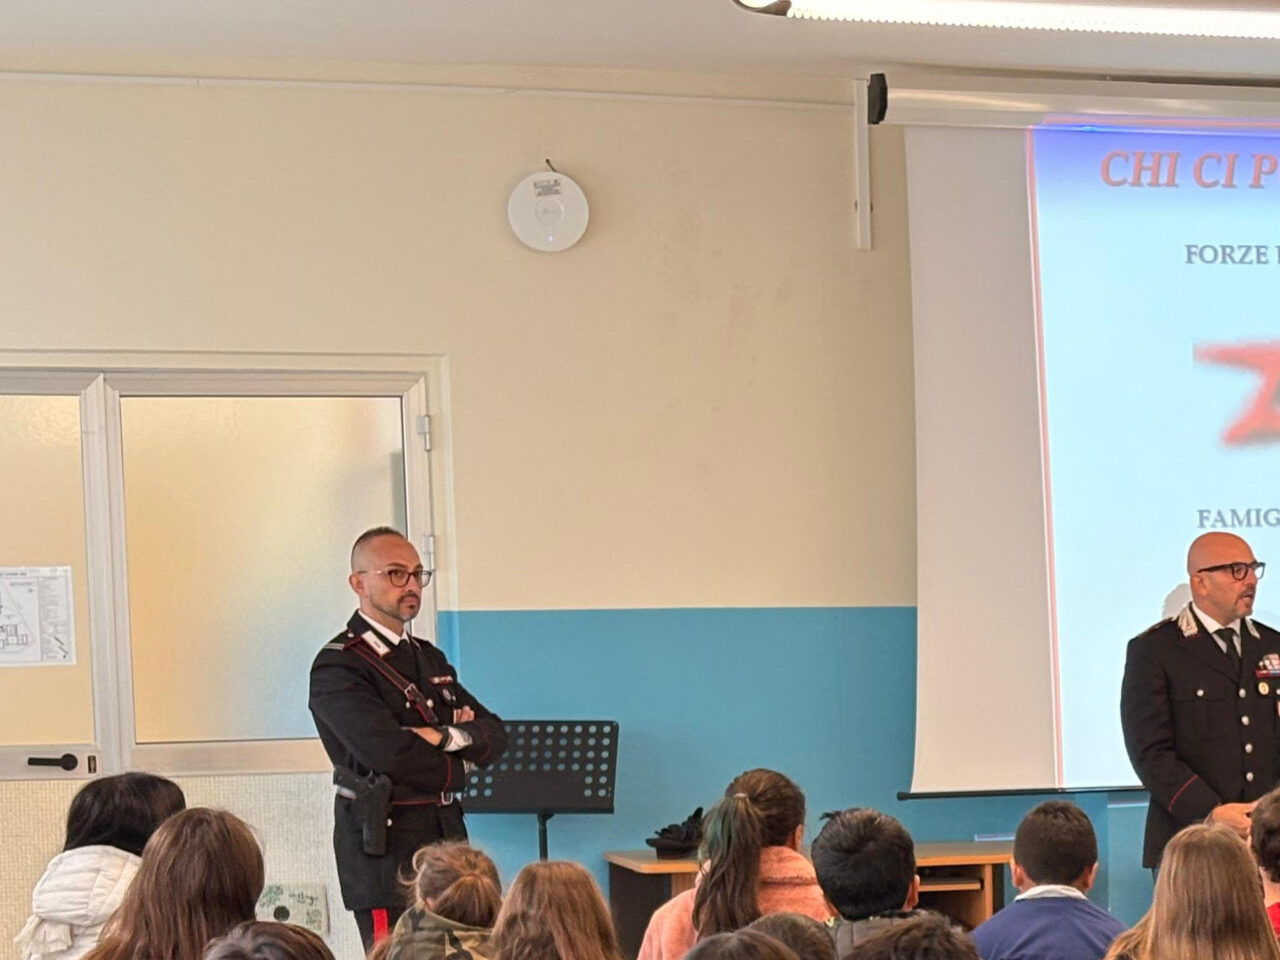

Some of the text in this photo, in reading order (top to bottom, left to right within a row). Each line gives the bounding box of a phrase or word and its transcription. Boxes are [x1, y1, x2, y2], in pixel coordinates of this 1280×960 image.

[1100, 151, 1180, 187] CHI
[1193, 152, 1238, 188] CI
[1184, 244, 1270, 265] FORZE
